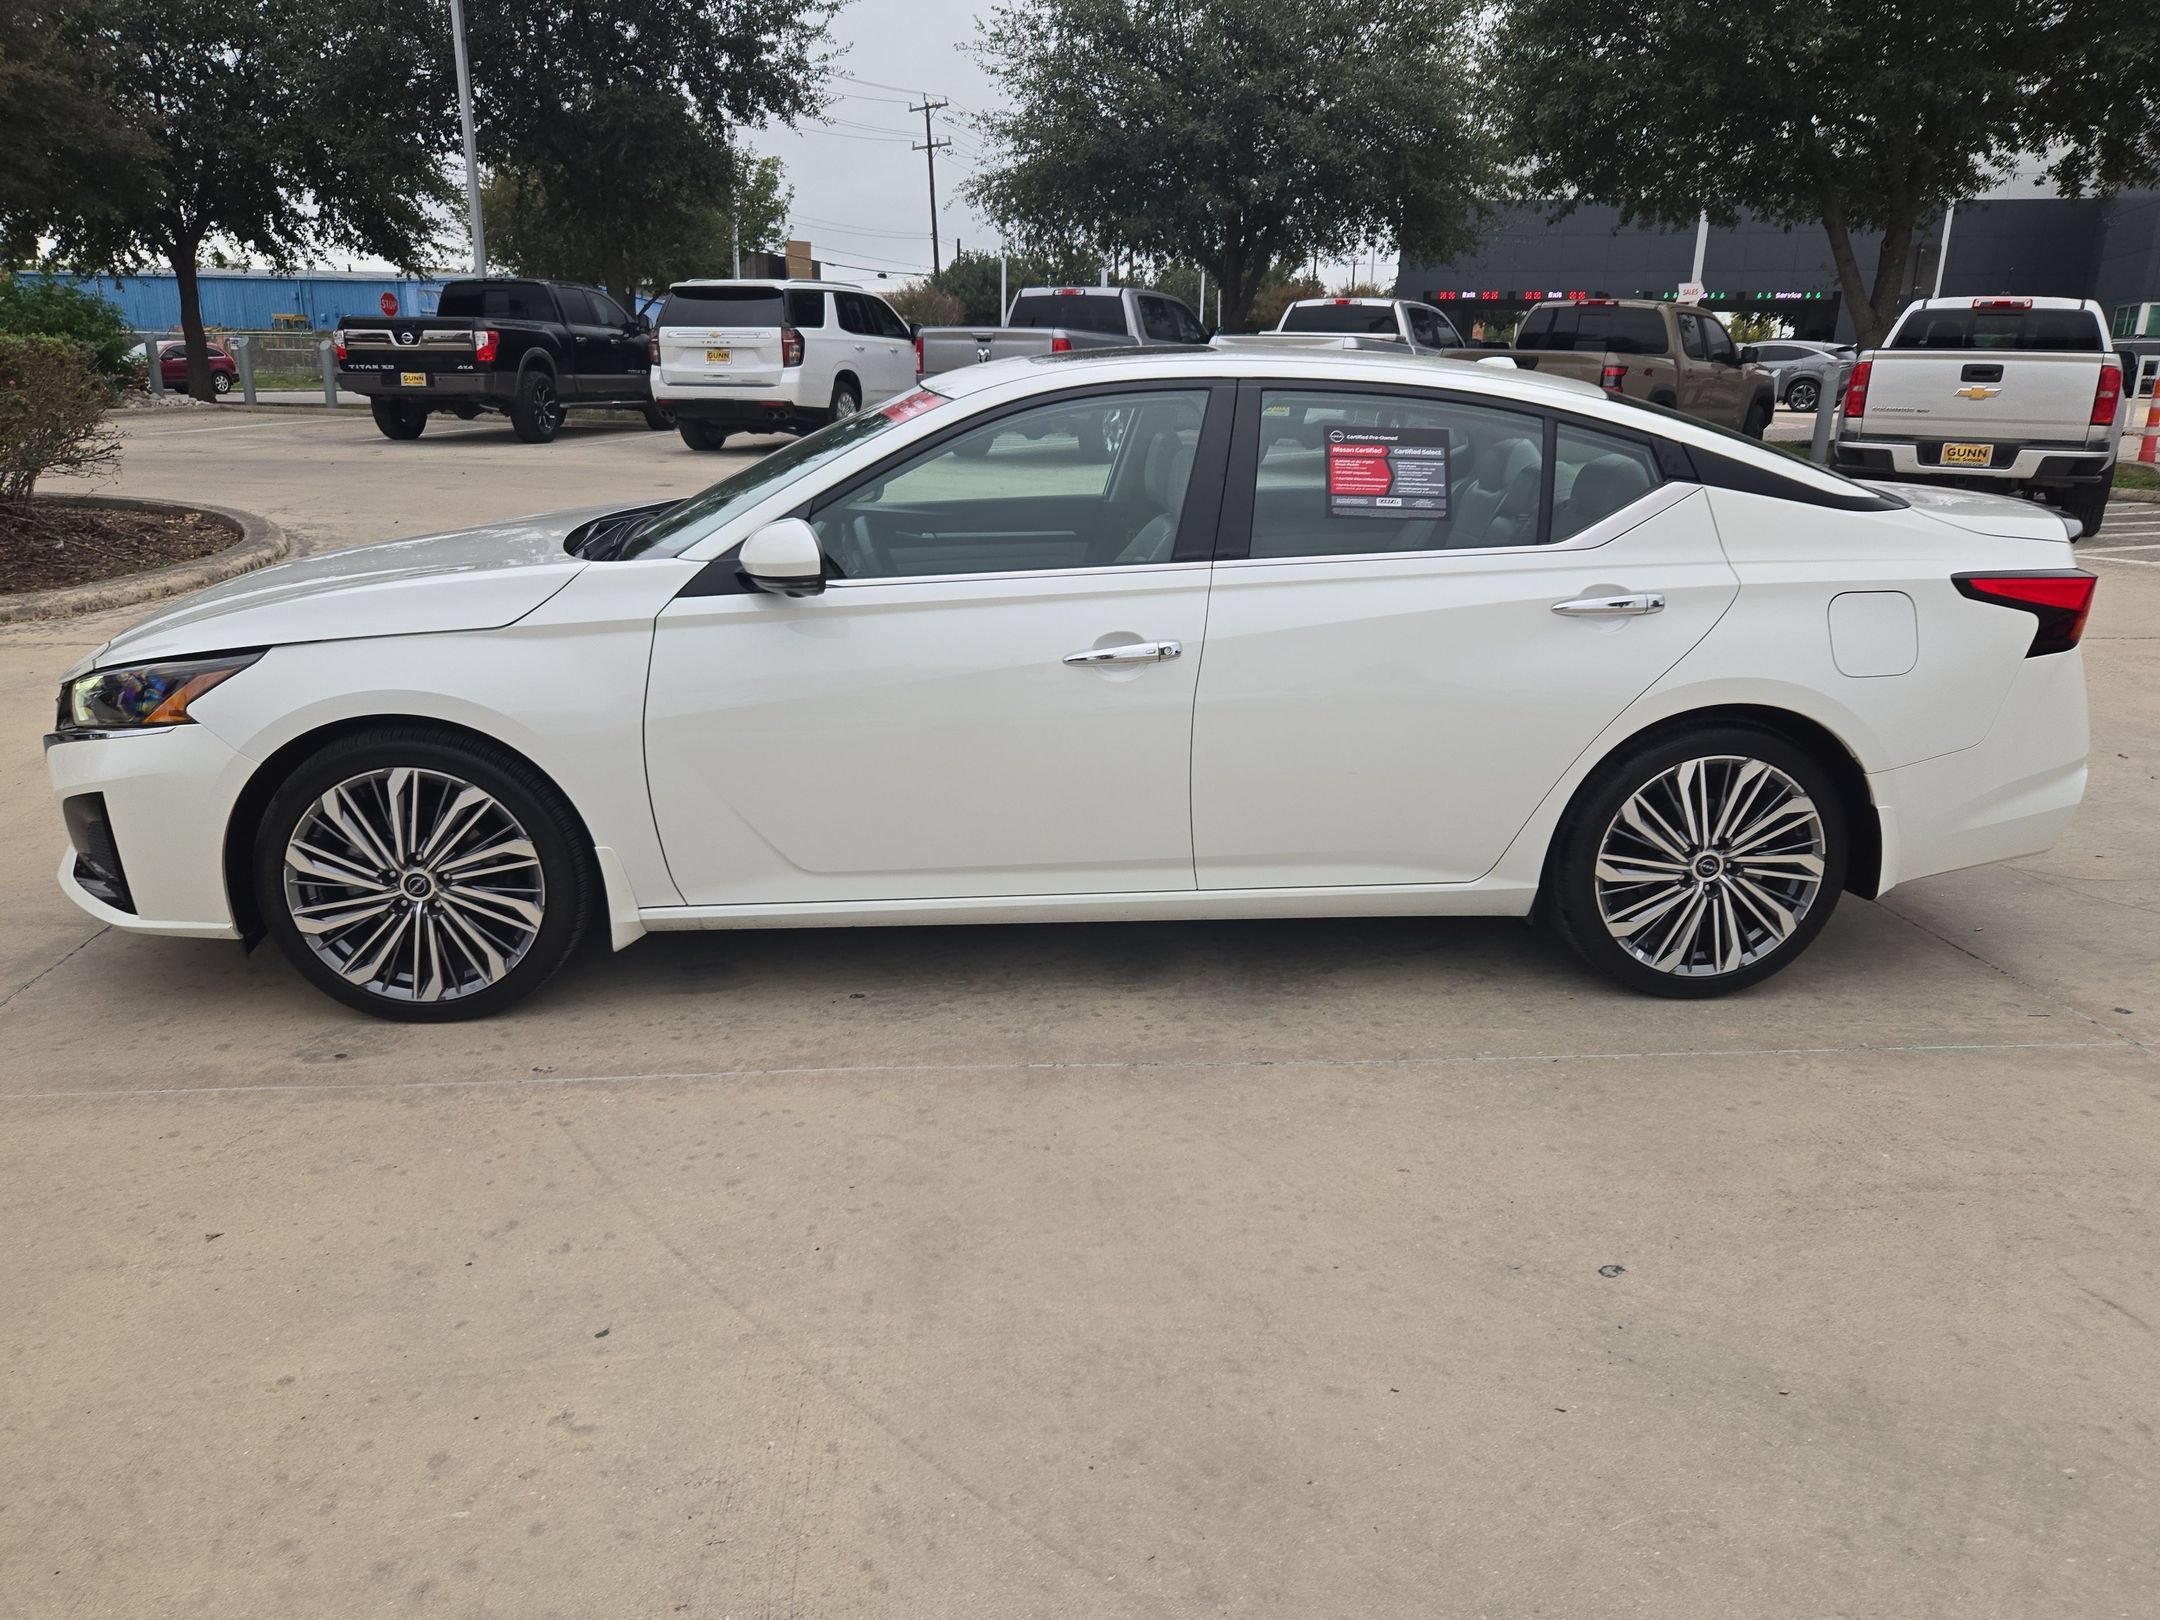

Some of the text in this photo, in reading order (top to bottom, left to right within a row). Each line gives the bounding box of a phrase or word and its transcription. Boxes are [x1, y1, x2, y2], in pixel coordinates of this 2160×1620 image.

[381, 298, 397, 309] STOP
[1355, 446, 1382, 454] Certified
[1422, 448, 1442, 456] Select
[1947, 448, 1988, 458] GUNN
